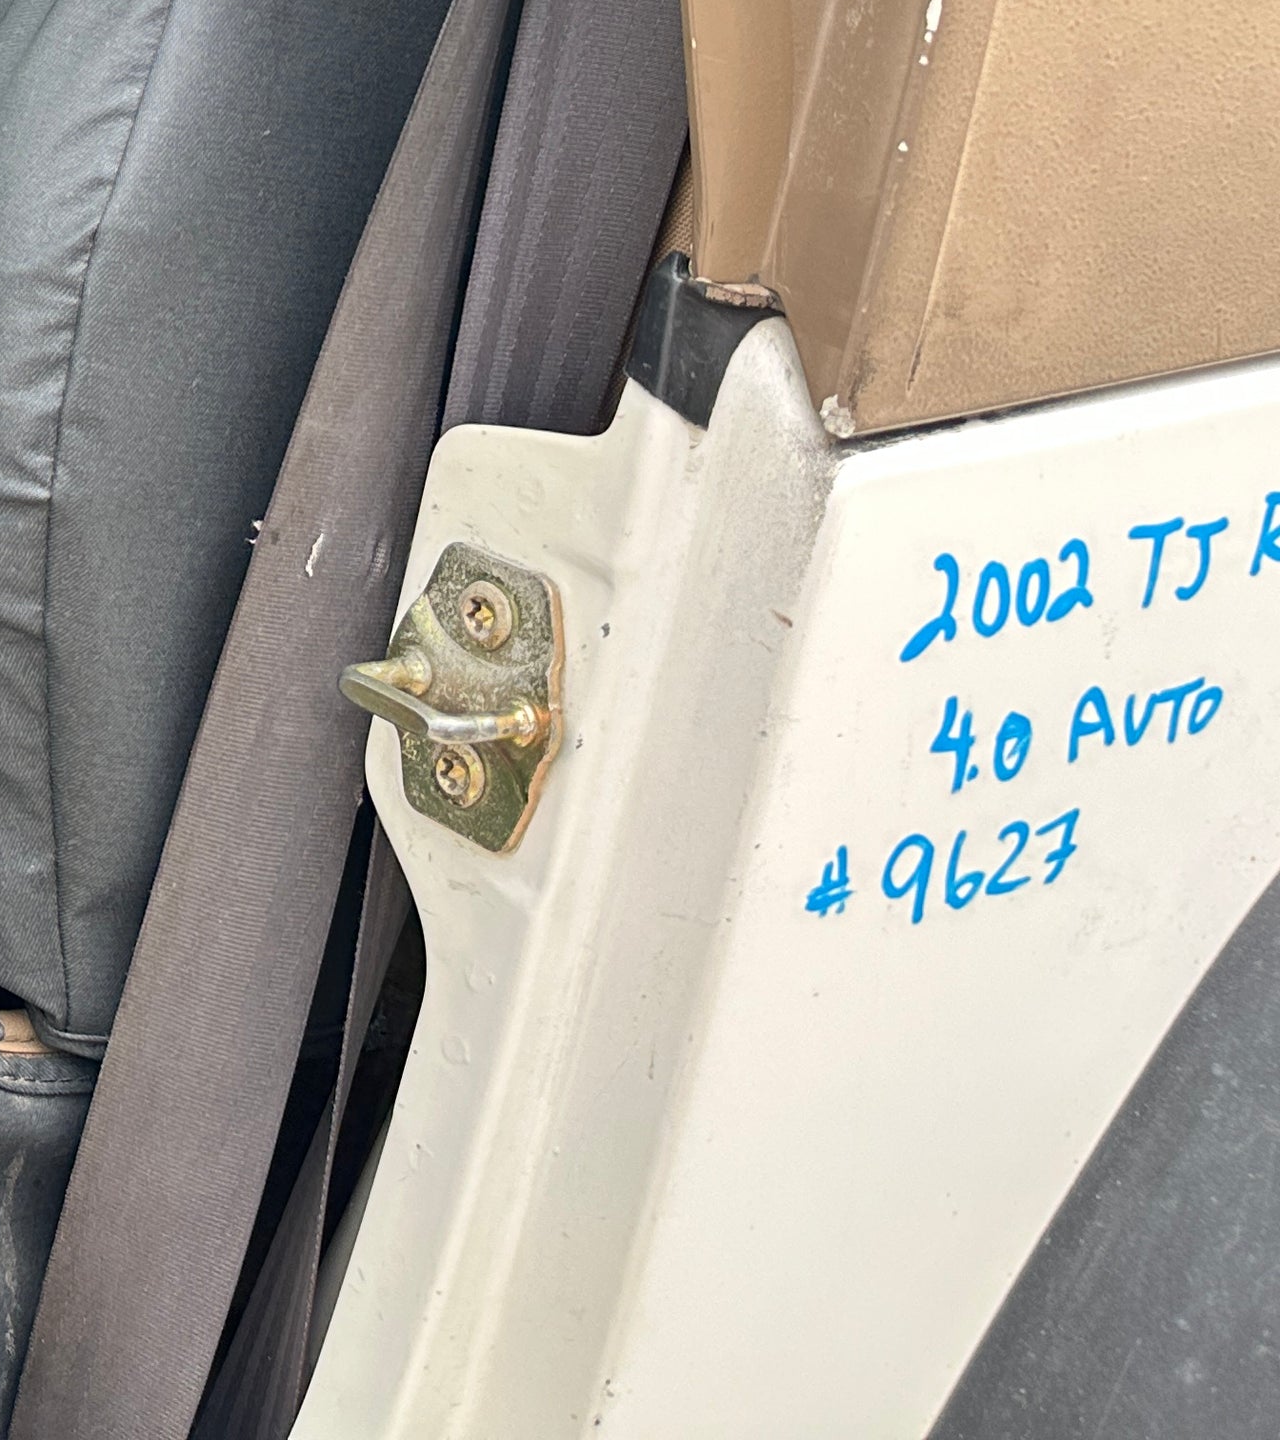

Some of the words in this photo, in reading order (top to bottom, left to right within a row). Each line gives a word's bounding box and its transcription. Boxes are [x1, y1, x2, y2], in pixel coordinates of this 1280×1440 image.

[900, 539, 1094, 663] 2002
[1128, 517, 1229, 608] TJ
[930, 696, 1033, 792] 4.0
[1068, 677, 1224, 763] AUTO
[881, 808, 1080, 924] 9627
